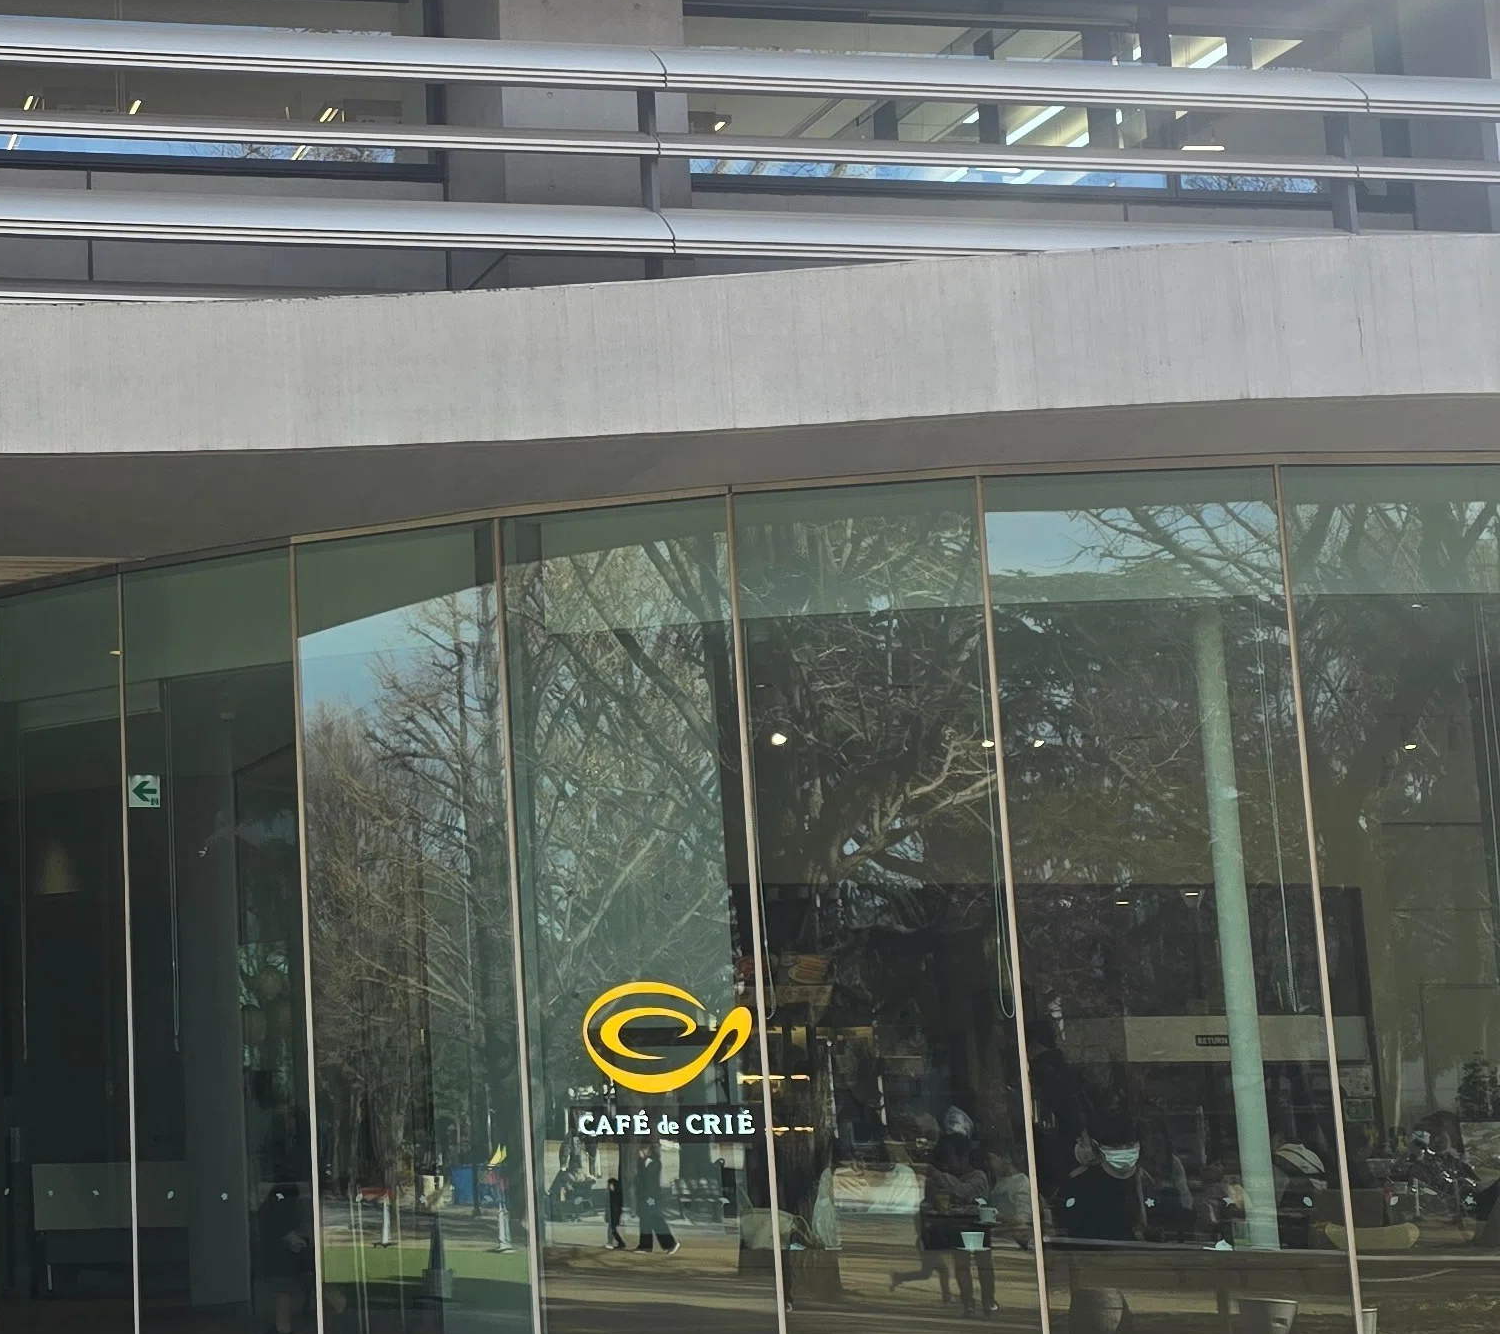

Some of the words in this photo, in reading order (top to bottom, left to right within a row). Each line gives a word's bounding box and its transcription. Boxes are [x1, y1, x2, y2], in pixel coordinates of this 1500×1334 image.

[578, 1109, 651, 1136] CAFÉ
[657, 1114, 680, 1135] de
[685, 1109, 756, 1135] CRIÉ
